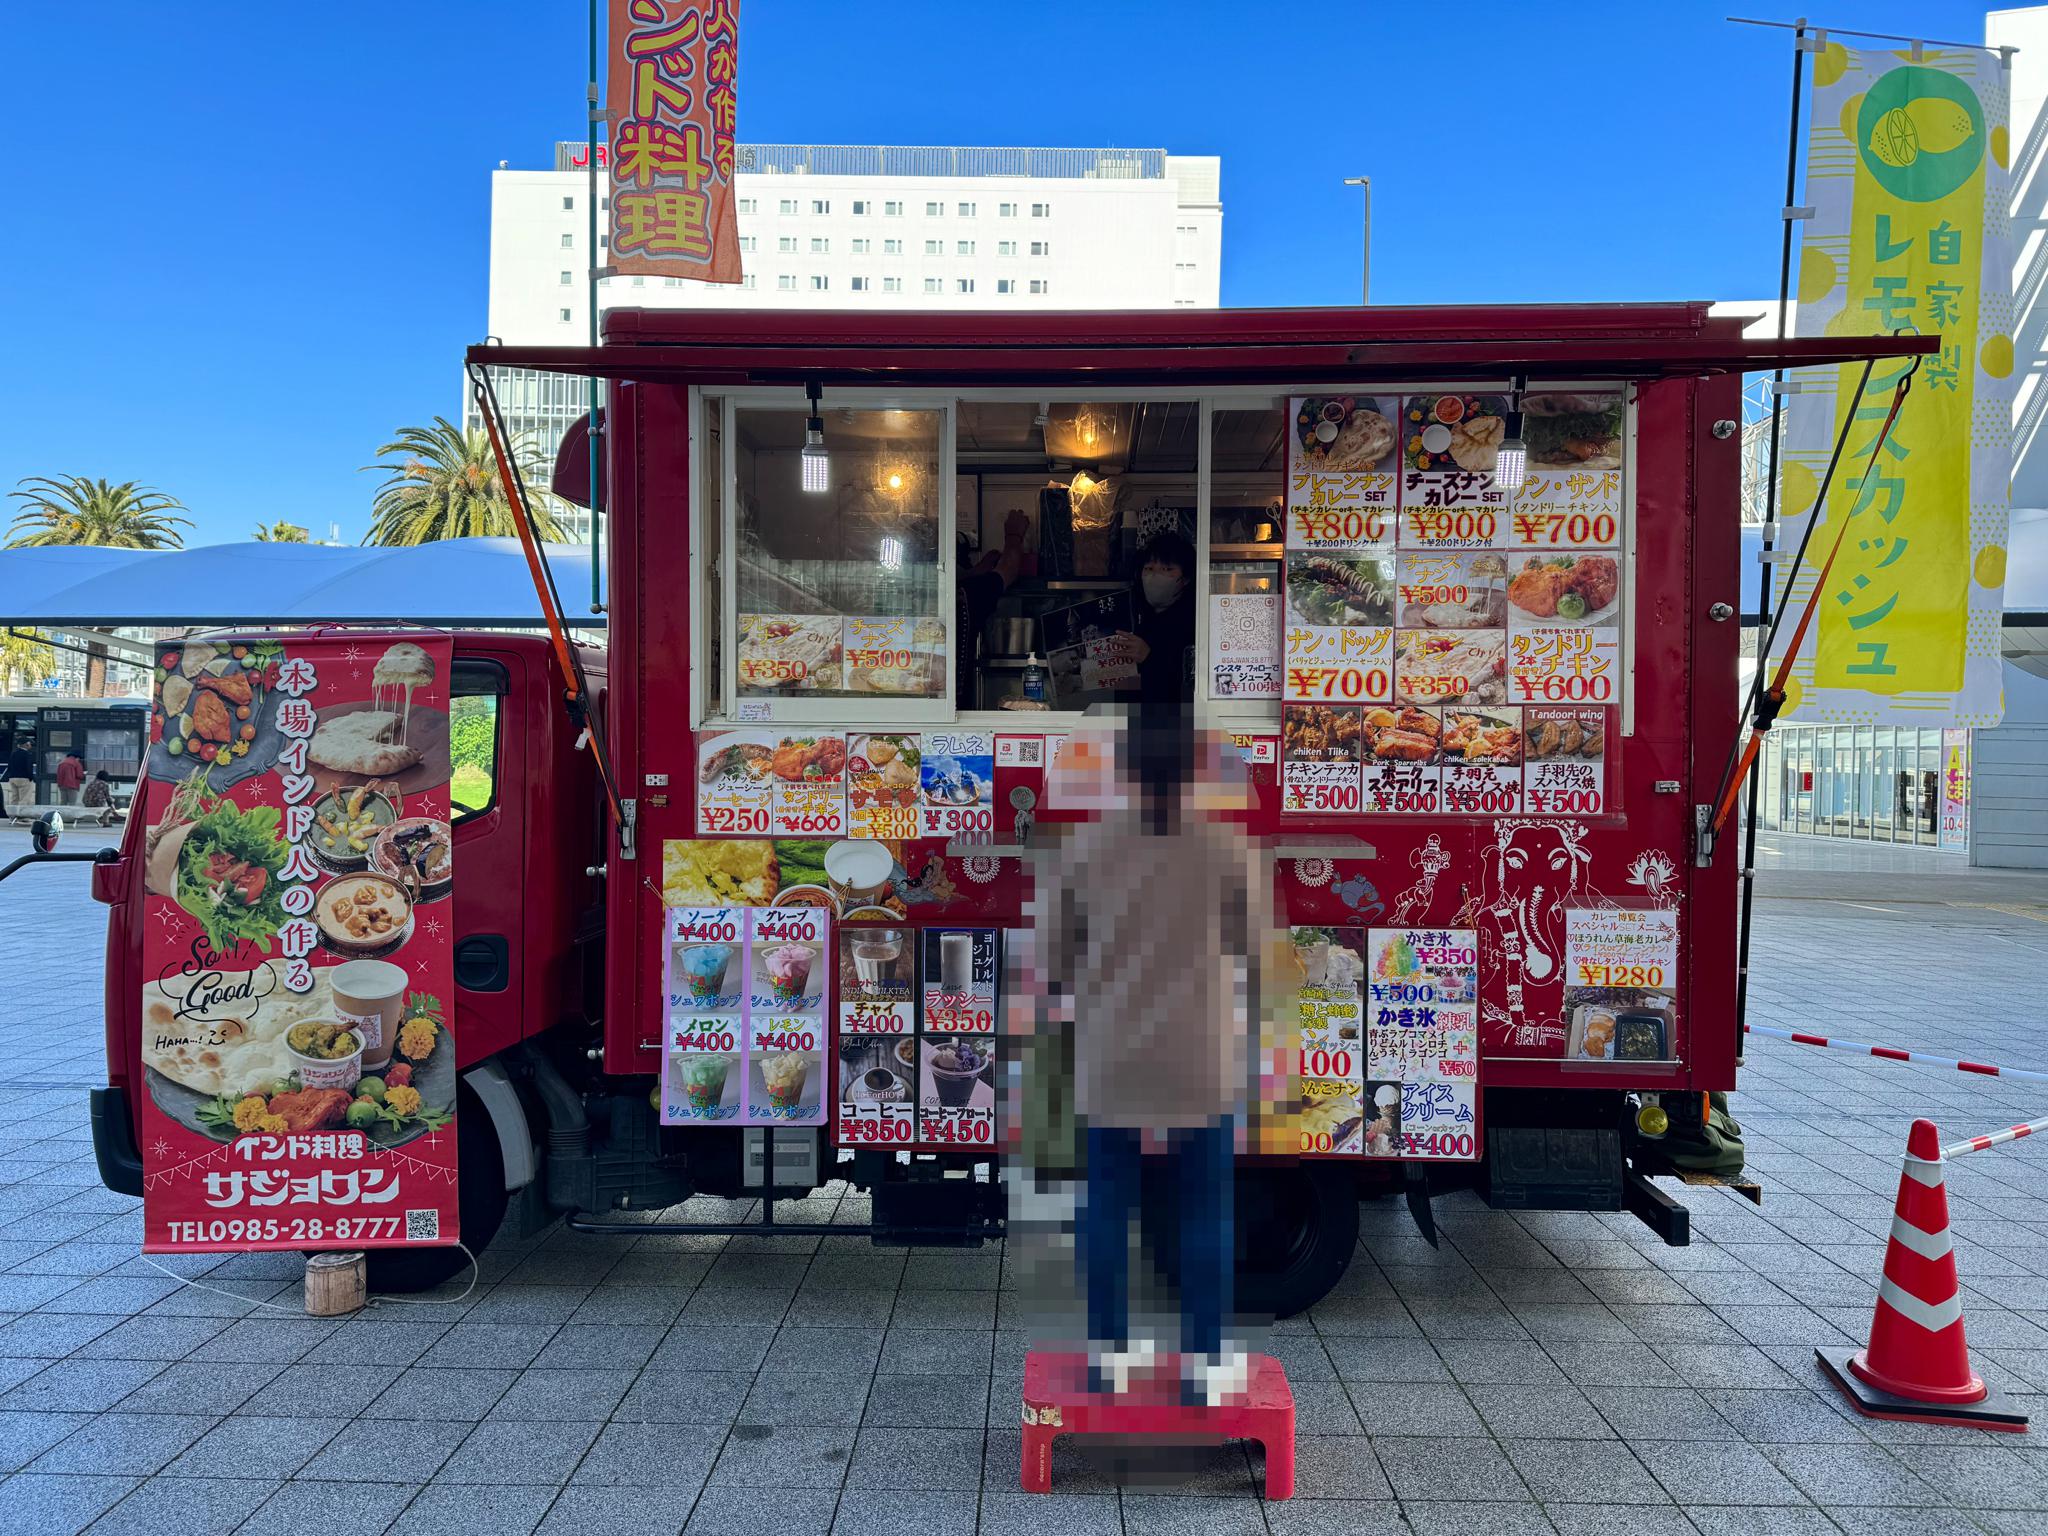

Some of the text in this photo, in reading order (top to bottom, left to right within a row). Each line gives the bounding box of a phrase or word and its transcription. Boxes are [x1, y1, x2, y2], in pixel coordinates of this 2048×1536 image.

[1923, 219, 1965, 393] 自家製
[1293, 472, 1394, 490] プレーンナン
[1406, 472, 1496, 491] チーズナン
[1309, 488, 1387, 505] カレー SET
[1424, 488, 1504, 506] カレー SET
[1295, 512, 1385, 540] ¥800
[1409, 512, 1496, 539] ¥900
[1513, 513, 1616, 544] ¥700
[1403, 552, 1463, 570] チーズ
[1415, 566, 1449, 584] ナン
[1400, 585, 1468, 605] ¥500
[849, 617, 904, 635] チーズ
[861, 631, 893, 647] ナン
[1511, 634, 1617, 656] タンドリー
[741, 659, 807, 680] ¥350
[846, 649, 912, 670] ¥500
[1214, 664, 1242, 672] インスタ
[1541, 654, 1611, 676] チキン
[1239, 672, 1273, 682] ジュース
[1288, 667, 1389, 698] ¥700
[1400, 675, 1470, 696] ¥350
[1514, 675, 1611, 701] ¥600
[1529, 709, 1604, 721] Tandoori wing
[932, 735, 983, 755] ラムネ
[1381, 766, 1423, 780] ポーク
[1452, 767, 1497, 781] 手羽元
[1537, 763, 1593, 777] 手羽先の
[717, 783, 762, 792] ジューシー
[1368, 778, 1438, 792] スペアリブ
[1534, 777, 1596, 790] スパイス焼
[700, 791, 773, 807] ソーセージ
[1289, 784, 1358, 810] ¥500
[1373, 791, 1437, 812] ¥500
[1446, 790, 1515, 812] ¥500
[1528, 789, 1601, 813] ¥500
[277, 659, 318, 991] 本場インド人の作る
[701, 807, 770, 832] ¥250
[785, 815, 841, 832] ¥600
[867, 807, 918, 823] ¥300
[924, 809, 992, 831] ¥300
[867, 823, 918, 839] ¥500
[688, 909, 731, 924] ソーダ
[766, 910, 809, 922] グレープ
[677, 923, 736, 941] ¥400
[757, 922, 816, 941] ¥400
[1405, 931, 1453, 947] かき氷
[181, 935, 221, 976] So
[982, 933, 994, 992] ヨーグルト
[1416, 948, 1477, 965] ¥350
[972, 944, 983, 991] ジュース
[1579, 965, 1663, 987] ¥1280
[173, 969, 255, 1020] Good
[925, 990, 993, 1008] ラッシー
[1370, 984, 1433, 1002] ¥500
[855, 1002, 895, 1016] チャイ
[1377, 1007, 1437, 1028] かき氷
[683, 1018, 729, 1034] メロン
[768, 1018, 806, 1032] レモン
[845, 1014, 904, 1033] ¥400
[925, 1008, 991, 1032] ¥350
[675, 1032, 734, 1051] ¥400
[755, 1032, 814, 1051] ¥400
[1379, 1029, 1389, 1058] ぶどう
[1389, 1029, 1398, 1058] ラムネ
[1418, 1029, 1428, 1068] マンゴー
[1428, 1029, 1437, 1058] メロン
[1437, 1029, 1447, 1058] イチゴ
[1439, 1060, 1476, 1076] ¥50
[1401, 1082, 1455, 1103] アイス
[842, 1103, 913, 1119] コーヒー
[920, 1107, 994, 1121] コーヒーフロート
[1401, 1101, 1474, 1122] クリーム
[841, 1119, 912, 1142] ¥350
[921, 1119, 990, 1142] ¥450
[235, 1134, 364, 1161] インド料理
[1401, 1132, 1474, 1156] ¥400
[202, 1168, 400, 1208] サジョワン
